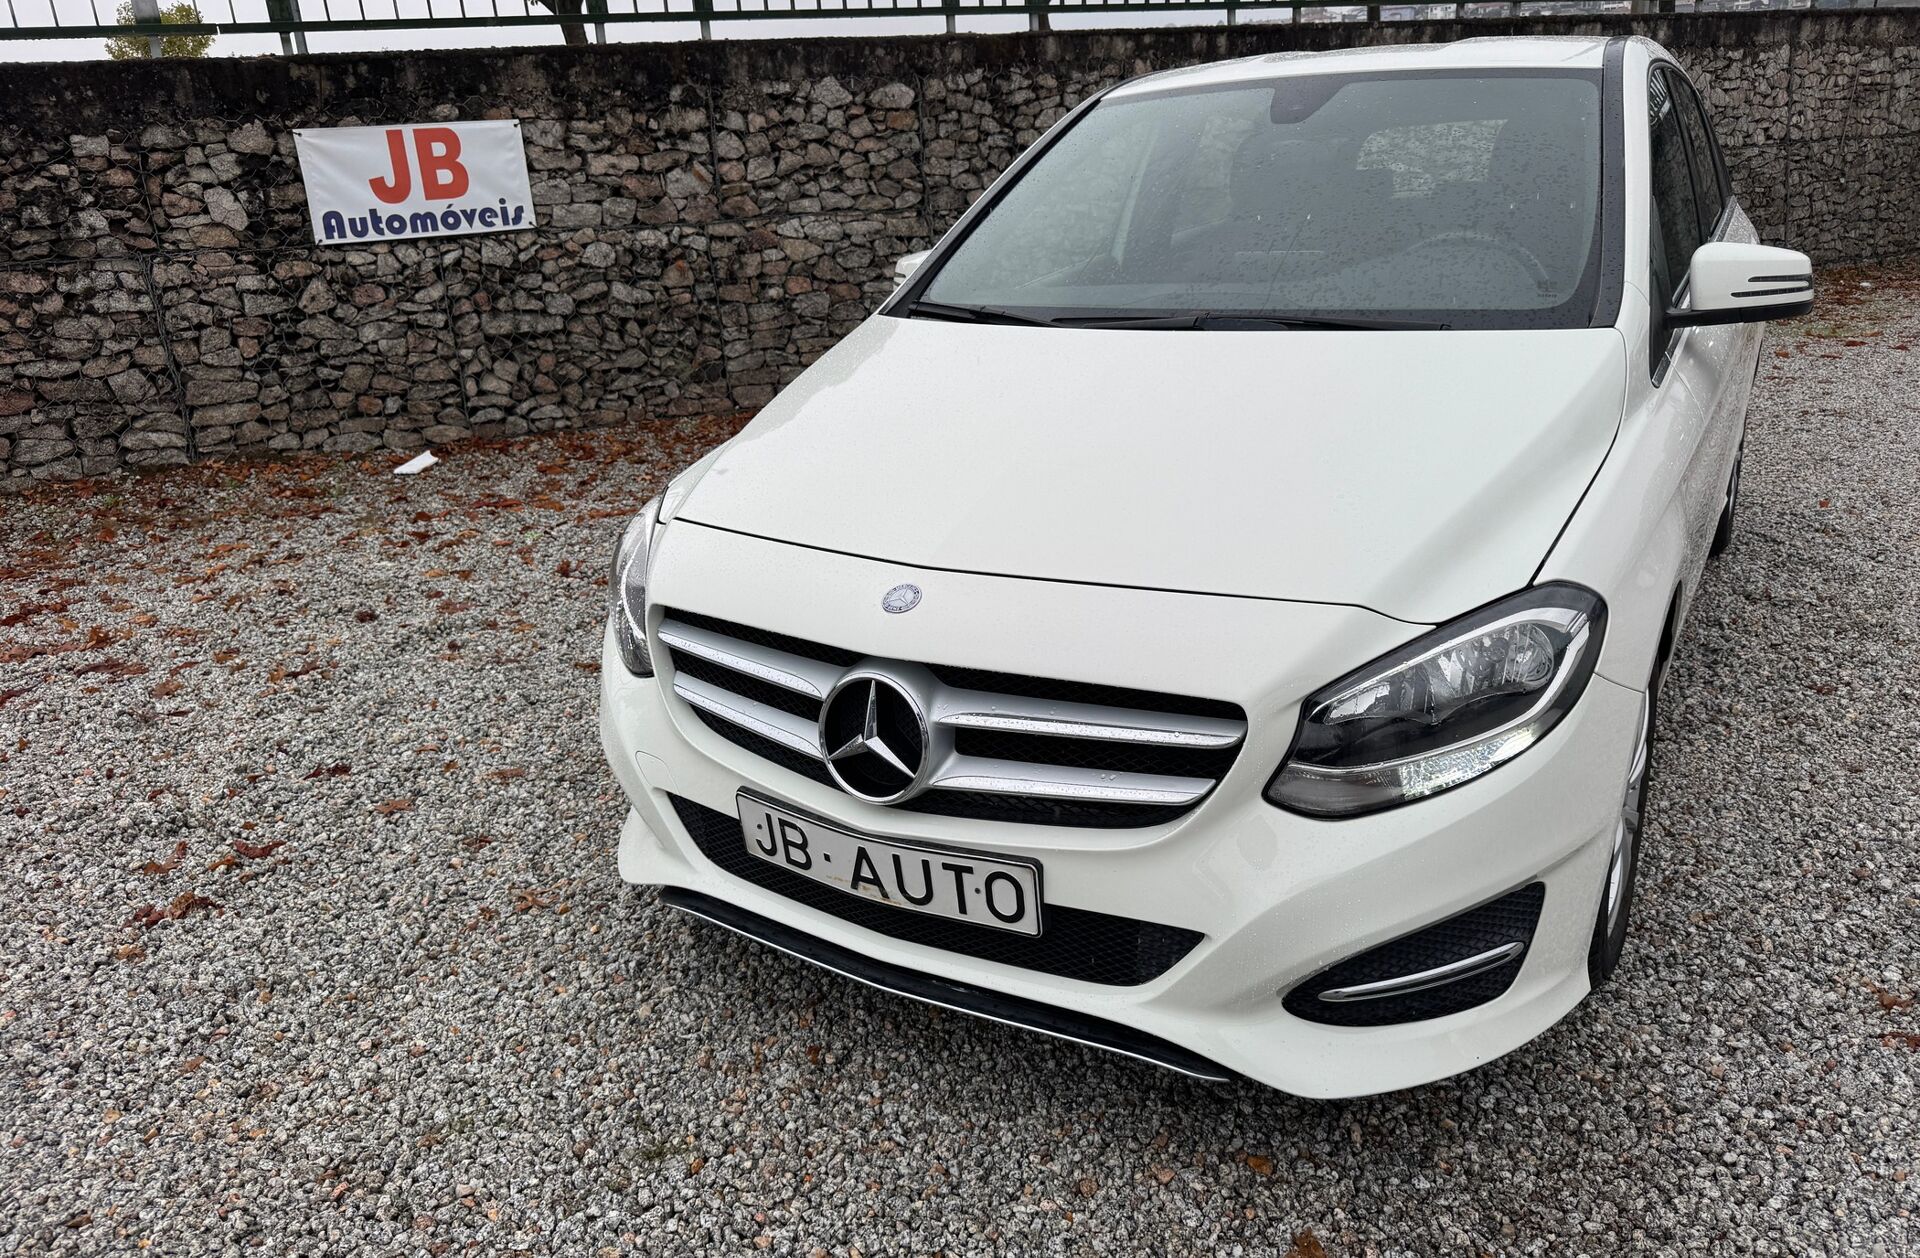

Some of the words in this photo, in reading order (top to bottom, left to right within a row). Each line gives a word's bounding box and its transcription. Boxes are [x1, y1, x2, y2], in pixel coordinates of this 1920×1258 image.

[368, 127, 469, 204] JB
[322, 198, 525, 240] Automóveis
[756, 813, 812, 870] JB
[850, 846, 1025, 924] AUTO
